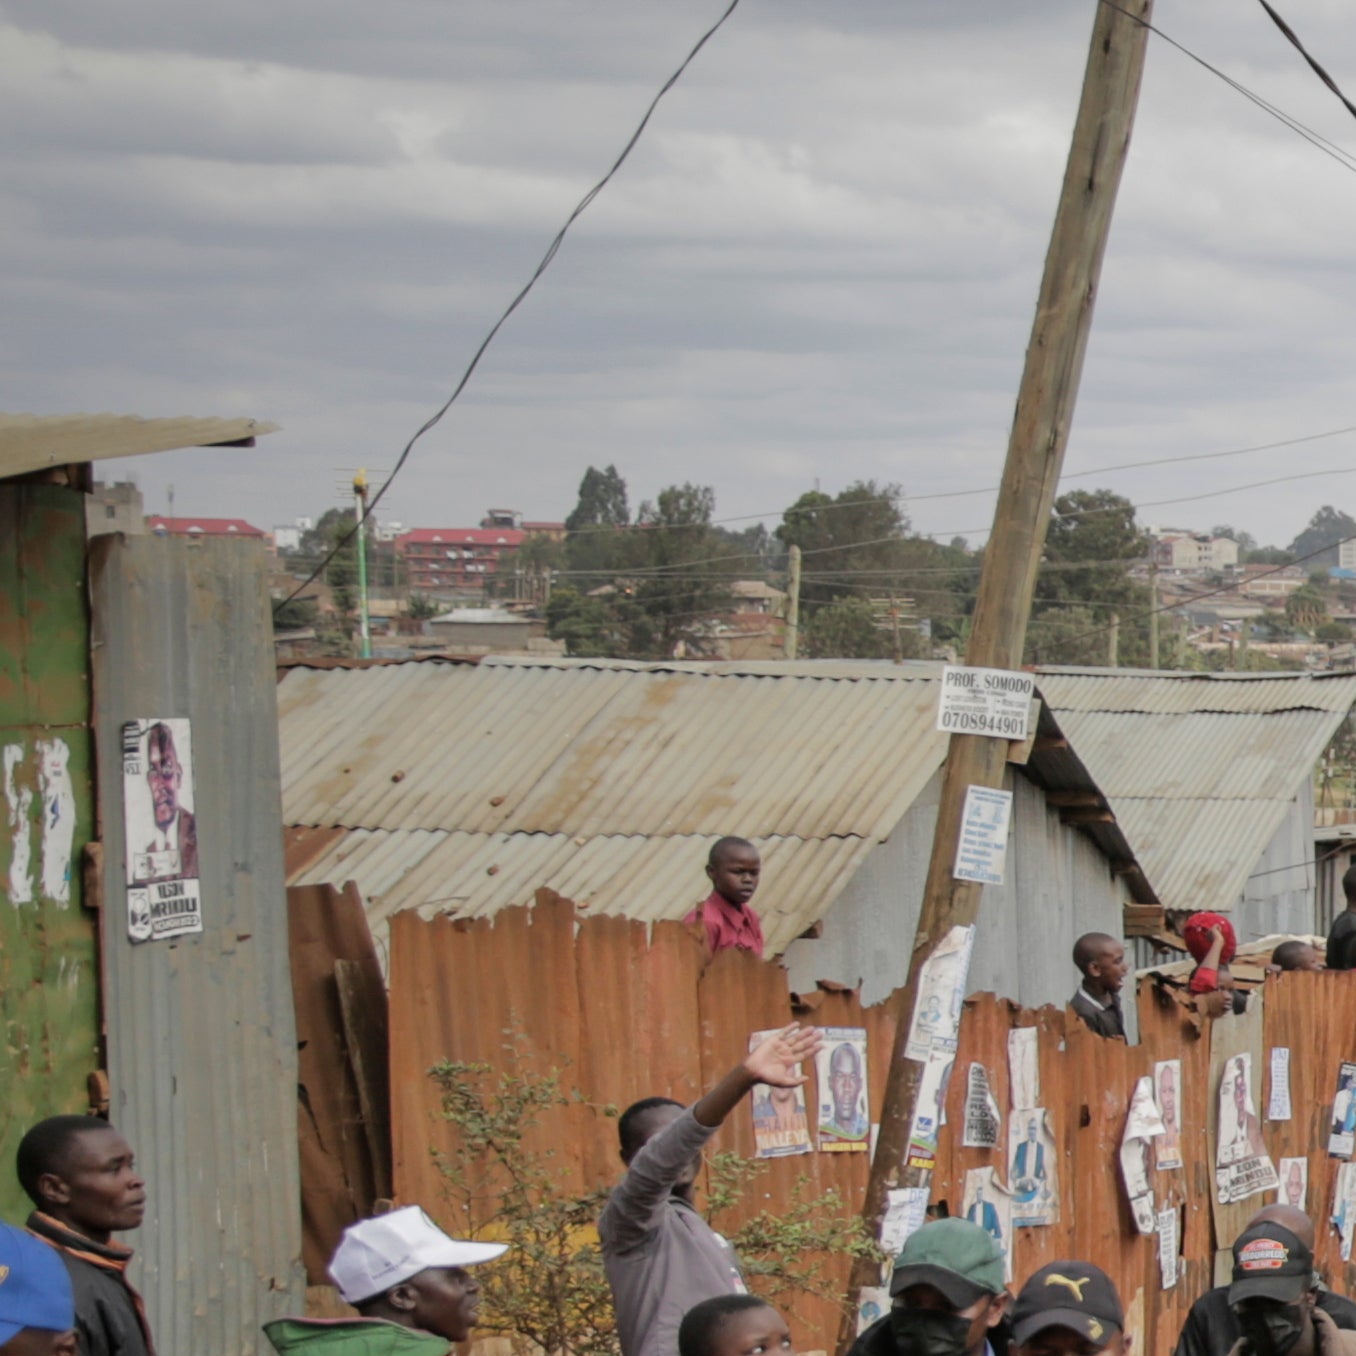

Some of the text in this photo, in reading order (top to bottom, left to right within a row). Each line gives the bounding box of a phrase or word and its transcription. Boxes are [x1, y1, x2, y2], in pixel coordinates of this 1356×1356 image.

[946, 672, 979, 688] PROF.
[984, 674, 1031, 694] SOMODO
[942, 711, 1025, 735] 0708944901
